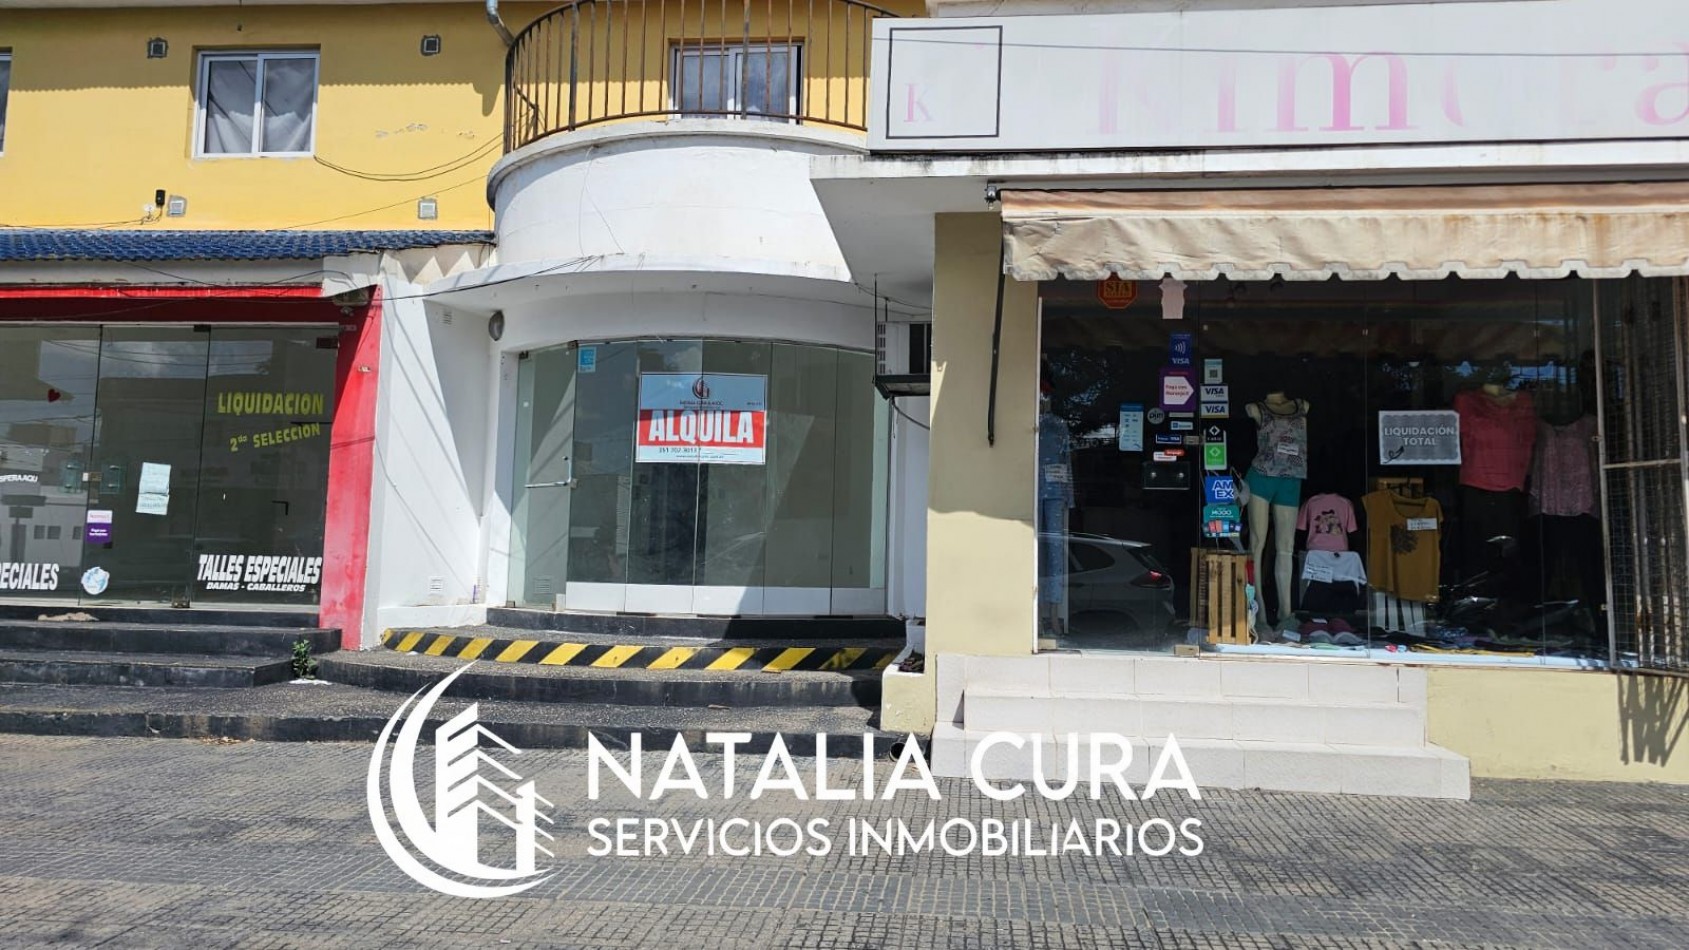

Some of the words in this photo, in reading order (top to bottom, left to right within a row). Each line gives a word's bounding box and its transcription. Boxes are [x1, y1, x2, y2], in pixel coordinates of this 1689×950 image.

[904, 83, 936, 123] K
[1171, 357, 1190, 365] VISA
[1204, 387, 1225, 395] VISA
[217, 391, 324, 416] LIQUIDACION
[1204, 405, 1226, 414] VISA
[648, 410, 754, 445] ALQUILA
[1384, 424, 1455, 437] LIQUIDACIÓN
[252, 422, 321, 449] SELECCION
[1402, 437, 1437, 446] TOTAL
[1212, 479, 1233, 490] AM
[1215, 490, 1234, 499] EX
[197, 554, 245, 582] TALLES
[243, 555, 323, 585] ESPECIALES
[0, 561, 60, 591] ECIALES
[206, 582, 240, 591] DAMAS
[246, 583, 306, 593] CABALLEROS
